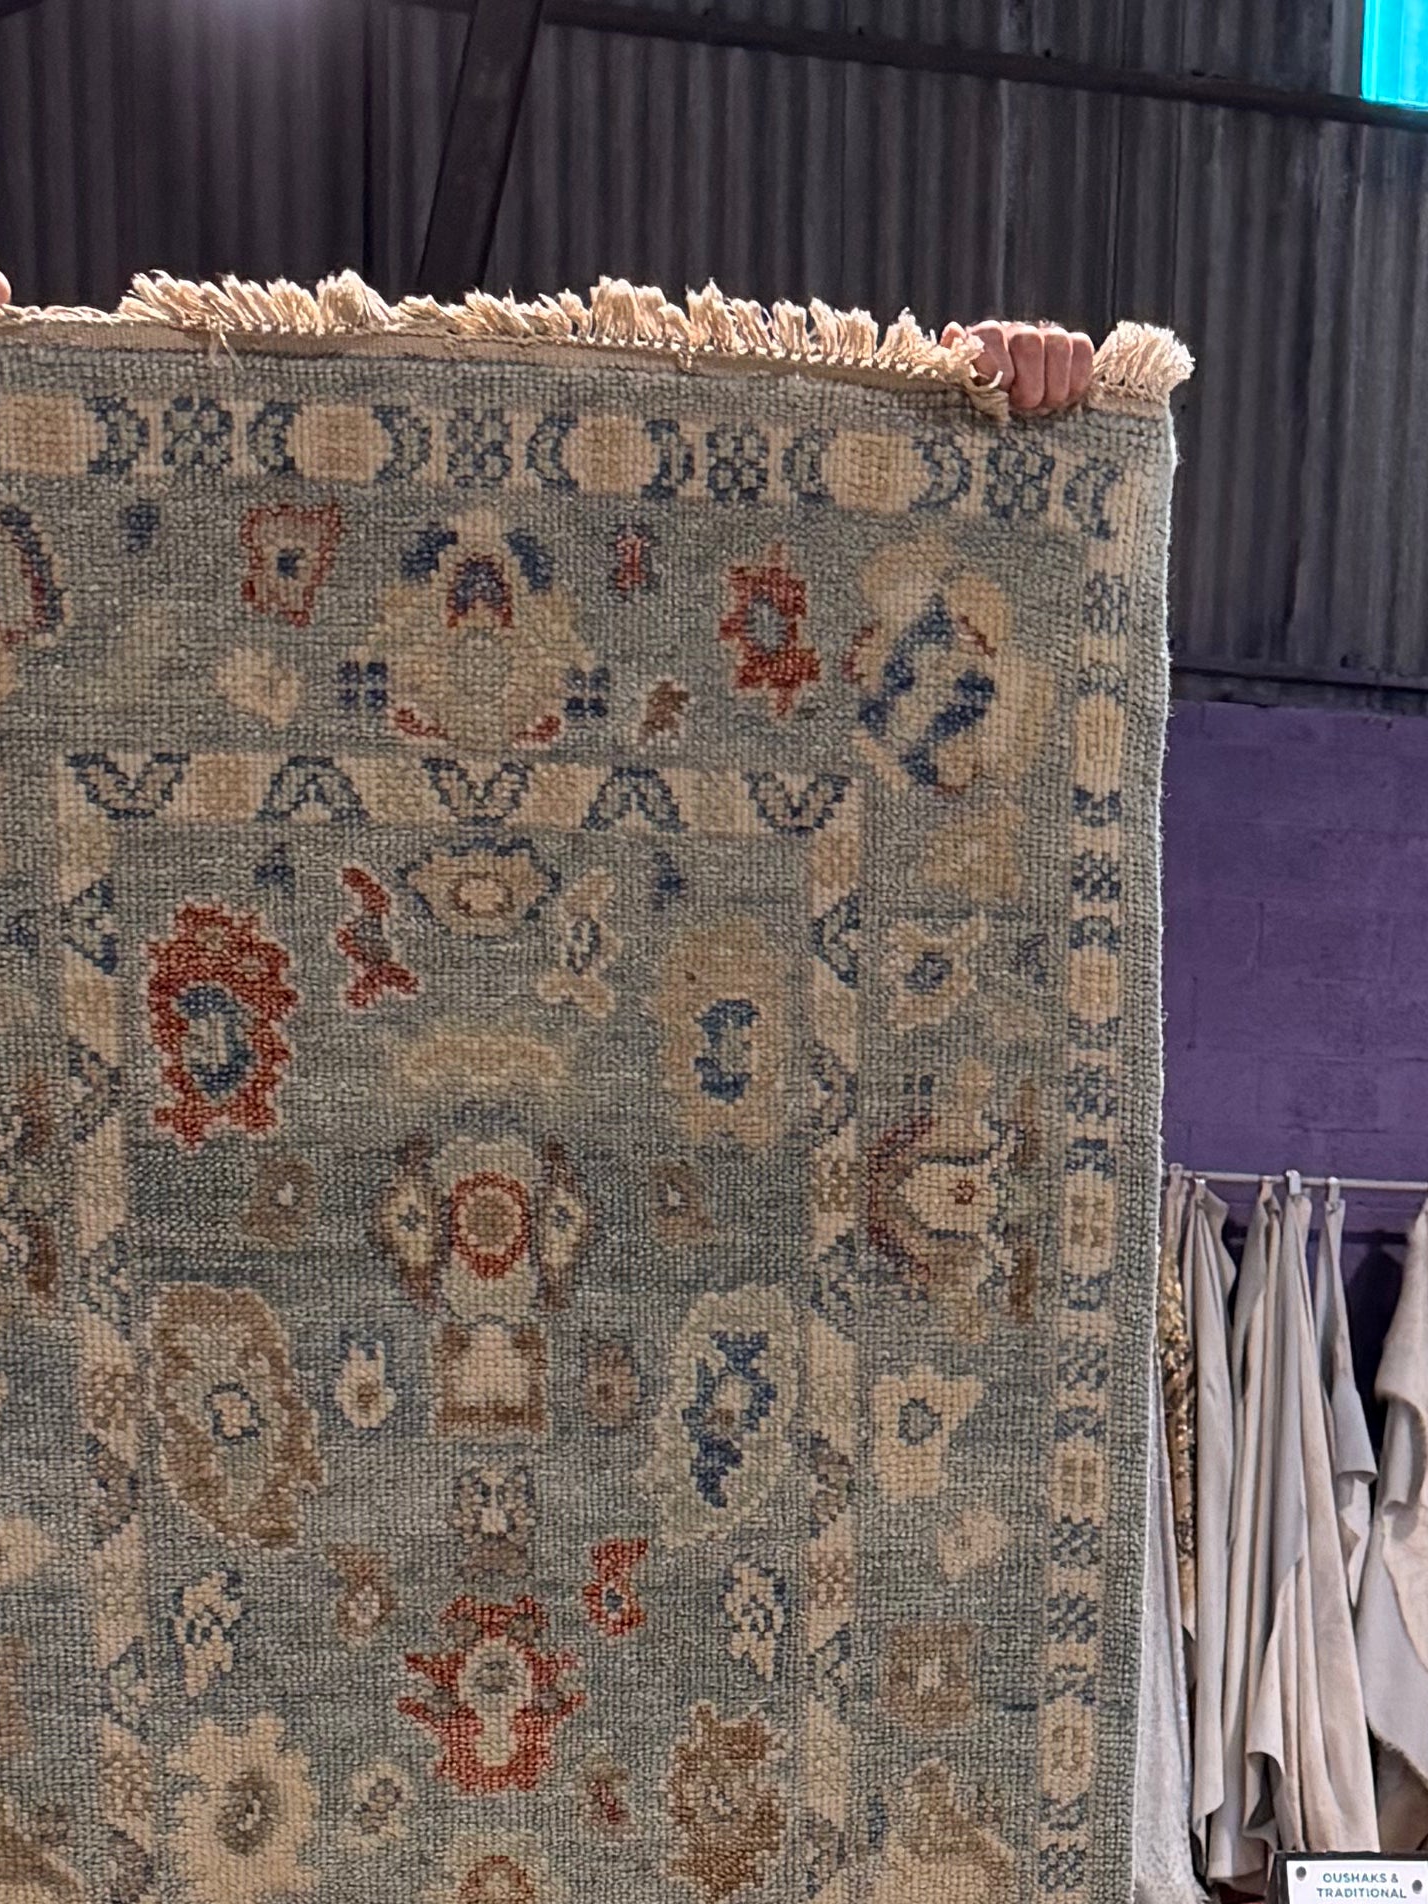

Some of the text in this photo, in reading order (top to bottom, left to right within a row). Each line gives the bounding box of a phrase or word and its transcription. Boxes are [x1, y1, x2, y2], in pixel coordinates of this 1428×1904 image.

[1322, 1872, 1400, 1884] OUSHAKS &
[1316, 1887, 1408, 1899] TRADITIONAL
